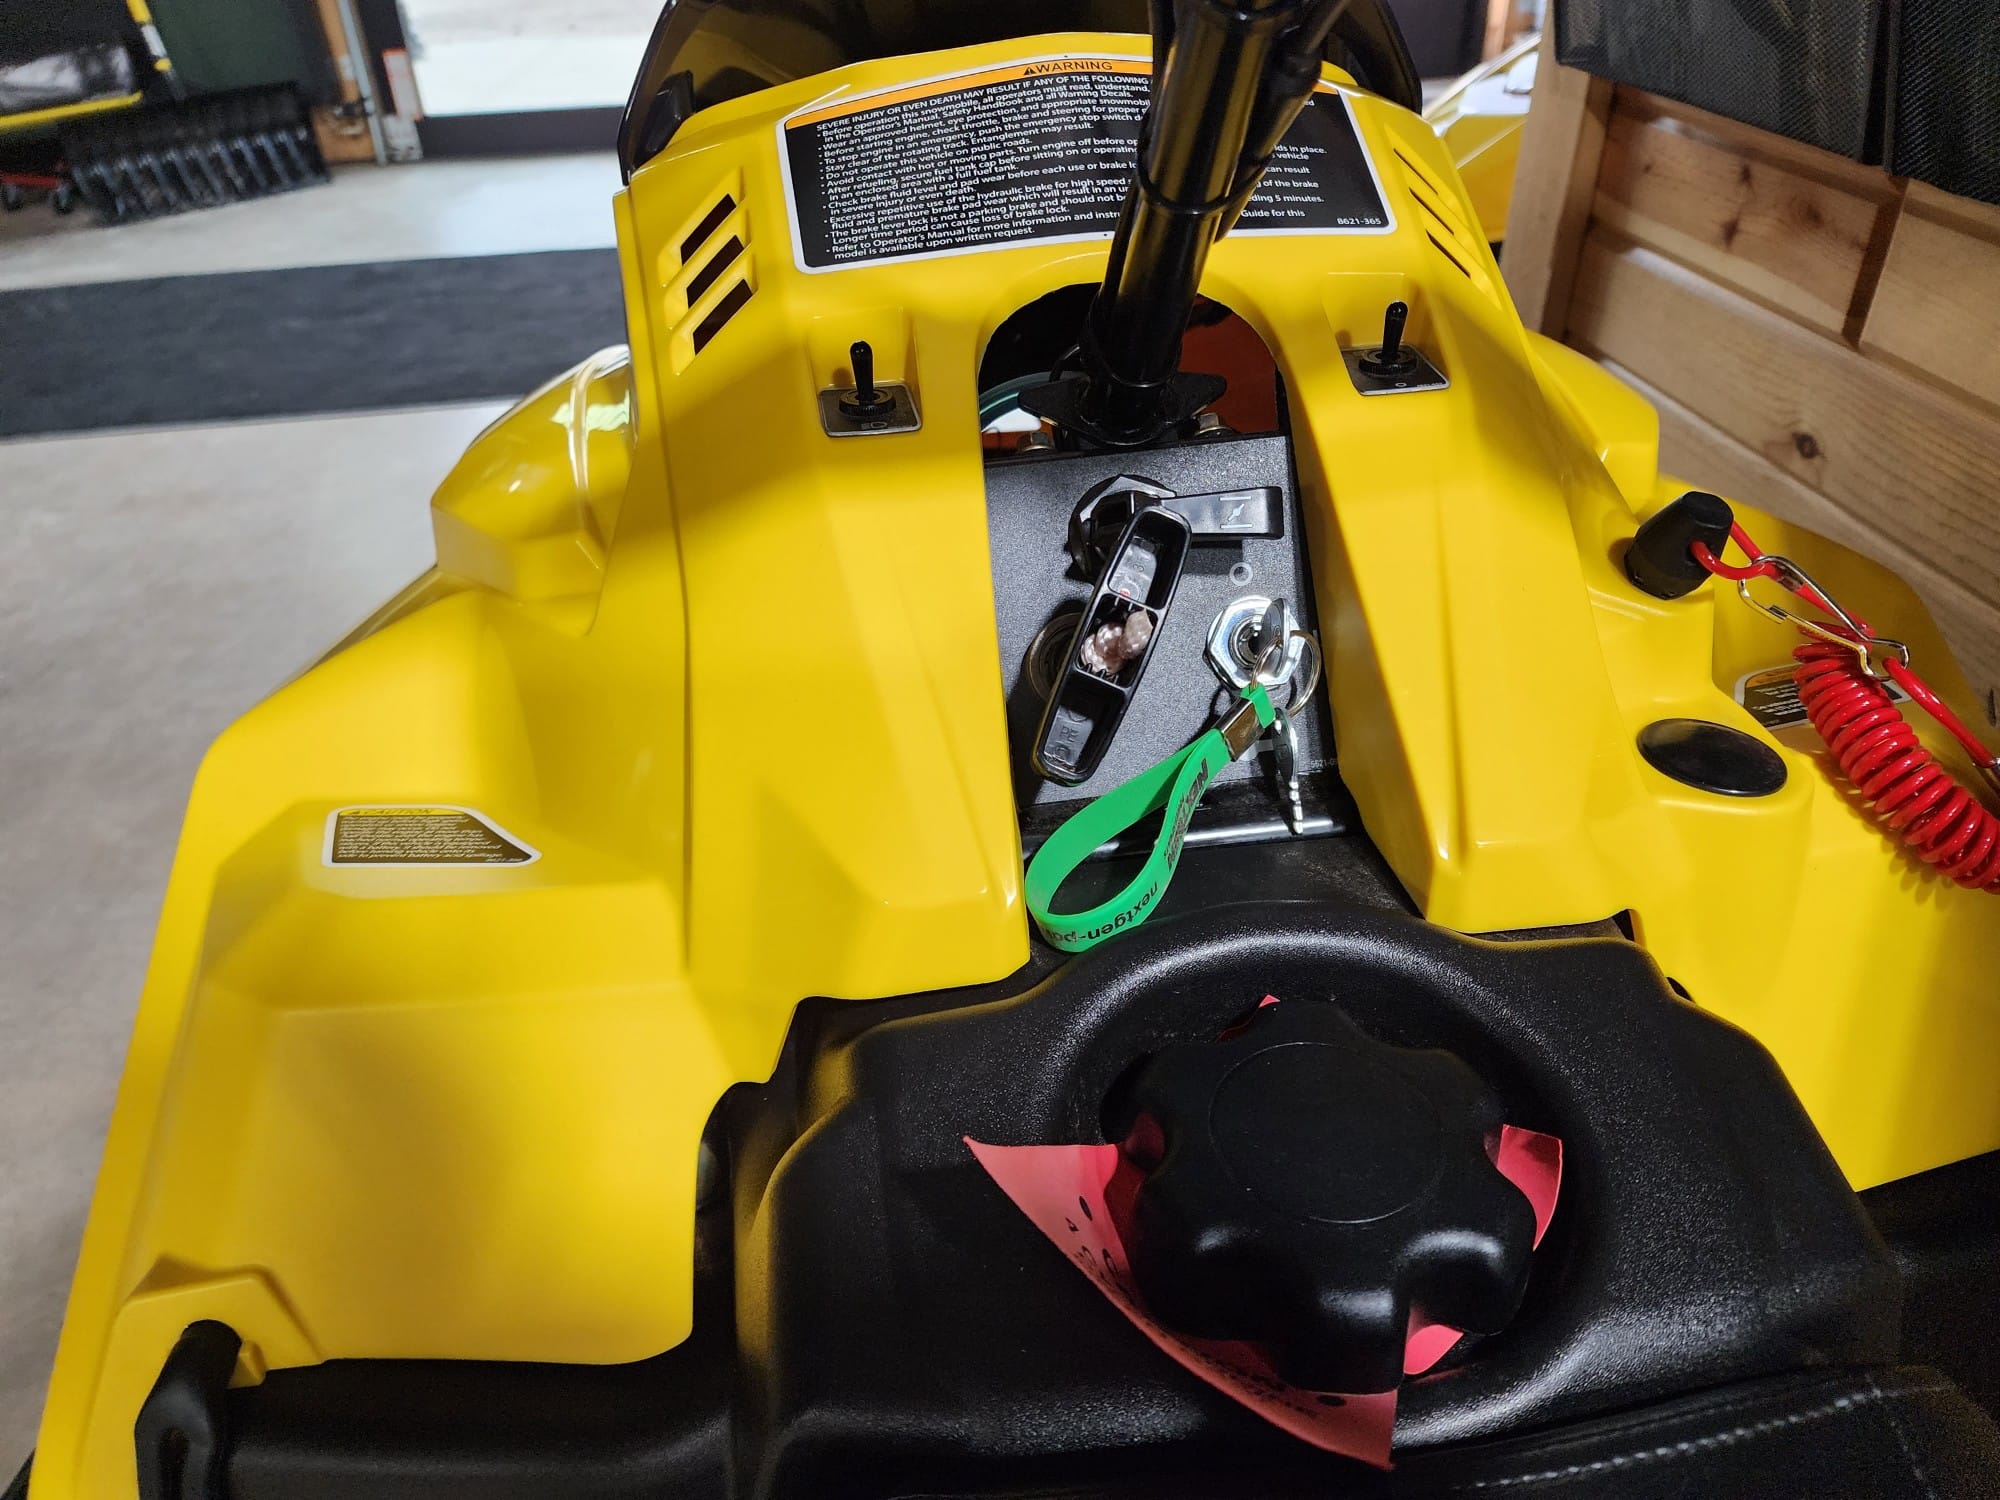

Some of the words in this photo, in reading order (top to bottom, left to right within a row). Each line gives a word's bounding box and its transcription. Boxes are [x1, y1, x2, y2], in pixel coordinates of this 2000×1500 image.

[1036, 62, 1112, 73] WARNING
[816, 117, 849, 130] SEVERE
[852, 110, 883, 123] INJURY
[903, 100, 927, 111] EVEN
[929, 93, 961, 105] DEATH
[963, 88, 983, 98] MAY
[986, 82, 1019, 94] RESULT
[1034, 78, 1052, 86] ANY
[1092, 75, 1148, 83] FOLLOWING
[822, 126, 851, 136] Before
[854, 116, 899, 130] operation
[901, 111, 918, 120] this
[983, 94, 993, 103] all
[995, 89, 1040, 101] operators
[1043, 85, 1067, 93] must
[823, 141, 846, 150] Wear
[863, 126, 907, 142] approved
[947, 117, 964, 125] eye
[1021, 103, 1038, 112] and
[1041, 98, 1096, 110] appropriate
[835, 132, 850, 140] the
[852, 122, 900, 137] Operator's
[942, 106, 971, 117] Safety
[973, 96, 1023, 111] Handbook
[1025, 93, 1043, 102] and
[1058, 90, 1098, 98] Warning
[824, 147, 854, 157] Before
[856, 139, 892, 151] starting
[932, 124, 959, 135] check
[1002, 112, 1028, 122] brake
[1031, 109, 1049, 117] and
[1051, 106, 1090, 115] steering
[825, 163, 844, 172] Stay
[847, 159, 869, 168] clear
[884, 153, 900, 161] the
[902, 145, 940, 157] rotating
[971, 127, 1038, 144] Entanglement
[838, 154, 858, 162] stop
[860, 147, 892, 158] engine
[978, 124, 1002, 136] push
[1022, 116, 1076, 127] emergency
[827, 176, 853, 186] Avoid
[856, 169, 892, 182] contact
[894, 165, 915, 175] with
[918, 161, 934, 170] hot
[950, 153, 986, 164] moving
[1042, 141, 1075, 150] engine
[842, 167, 858, 176] not
[860, 161, 897, 174] operate
[900, 157, 917, 166] this
[919, 151, 953, 162] vehicle
[970, 143, 1000, 155] public
[828, 197, 858, 208] Check
[860, 194, 887, 203] brake
[890, 189, 911, 198] fluid
[914, 184, 936, 194] level
[939, 181, 957, 190] and
[960, 177, 979, 188] pad
[981, 174, 1004, 183] wear
[1008, 170, 1039, 179] before
[1042, 165, 1065, 174] each
[830, 211, 874, 223] Excessive
[877, 203, 924, 216] repetitive
[977, 187, 1022, 200] hydraulic
[1025, 183, 1052, 192] brake
[1071, 179, 1093, 188] high
[1096, 177, 1125, 186] speed
[832, 244, 857, 252] Refer
[873, 234, 924, 247] Operator's
[927, 227, 964, 239] Manual
[983, 222, 1009, 230] more
[1012, 215, 1071, 227] information
[851, 226, 878, 235] brake
[881, 222, 904, 231] lever
[908, 217, 928, 227] lock
[940, 212, 957, 221] not
[968, 206, 1006, 218] parking
[1008, 202, 1036, 211] brake
[1039, 198, 1058, 207] and
[1060, 195, 1094, 204] should
[834, 248, 866, 259] model
[879, 242, 923, 253] available
[926, 238, 952, 247] upon
[955, 233, 991, 242] written
